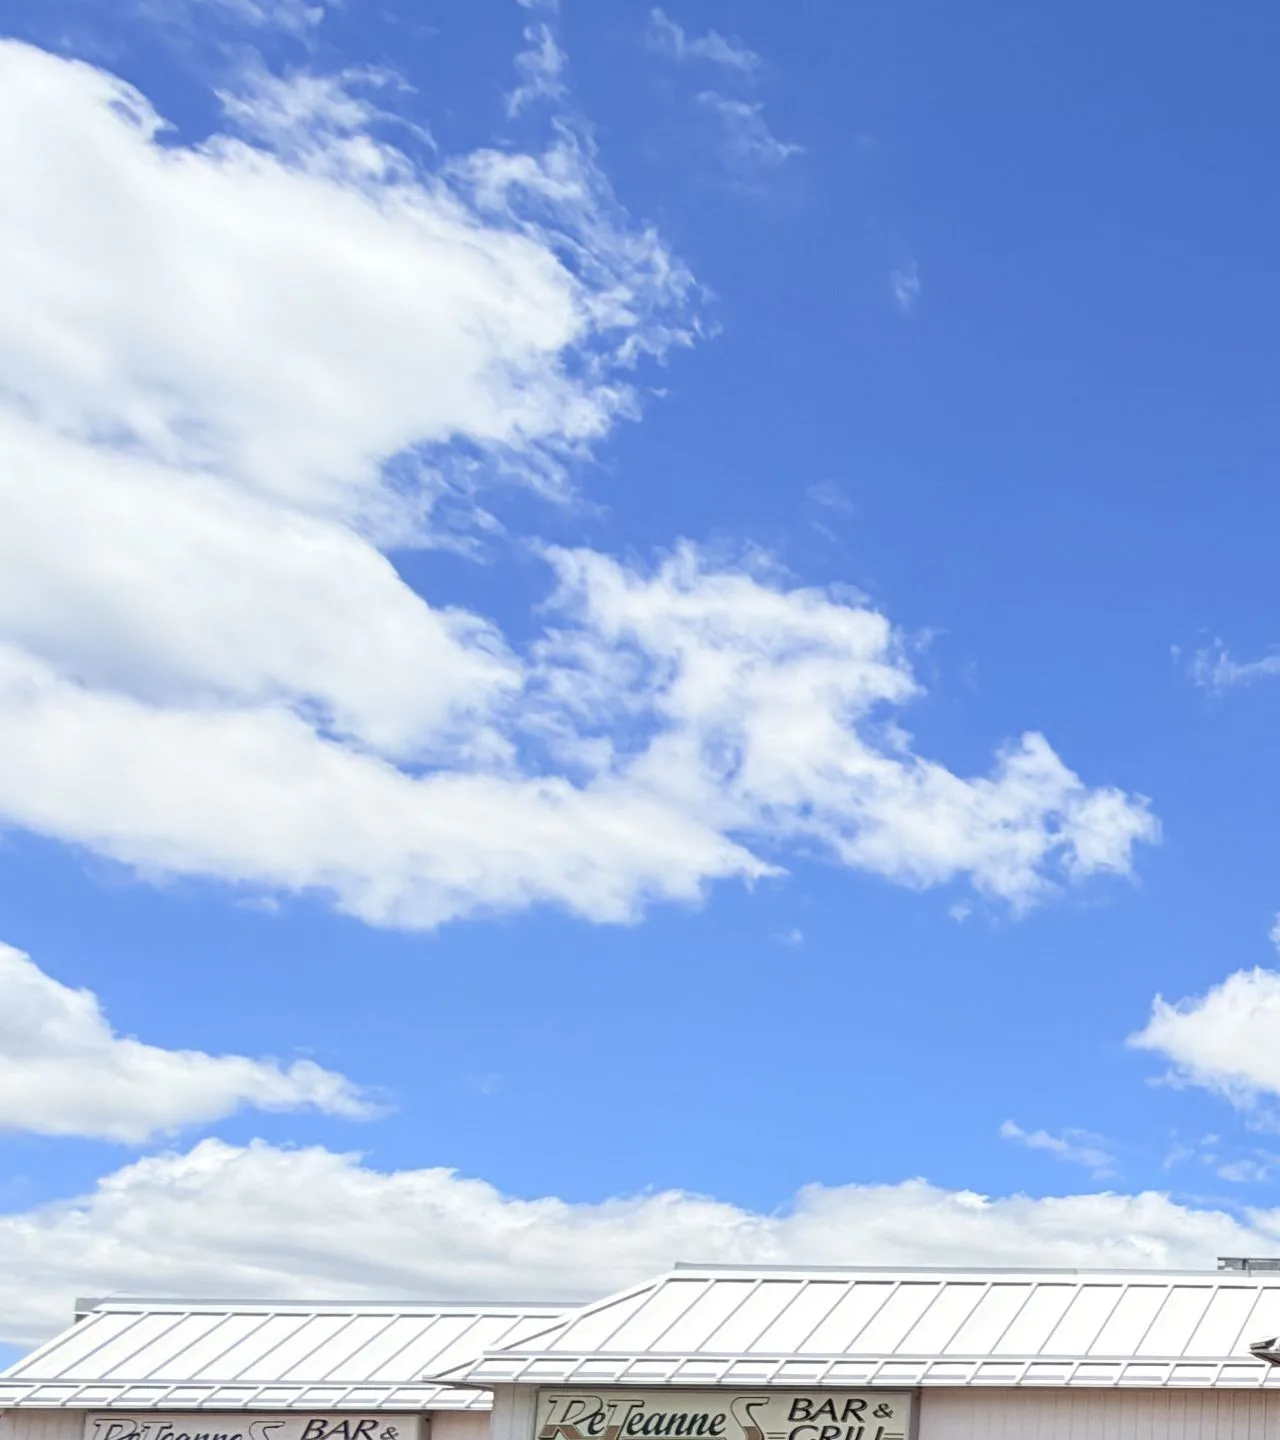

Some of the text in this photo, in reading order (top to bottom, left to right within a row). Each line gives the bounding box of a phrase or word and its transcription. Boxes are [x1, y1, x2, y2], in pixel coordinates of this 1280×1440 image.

[787, 1397, 894, 1422] BAR &
[379, 1426, 399, 1440] &
